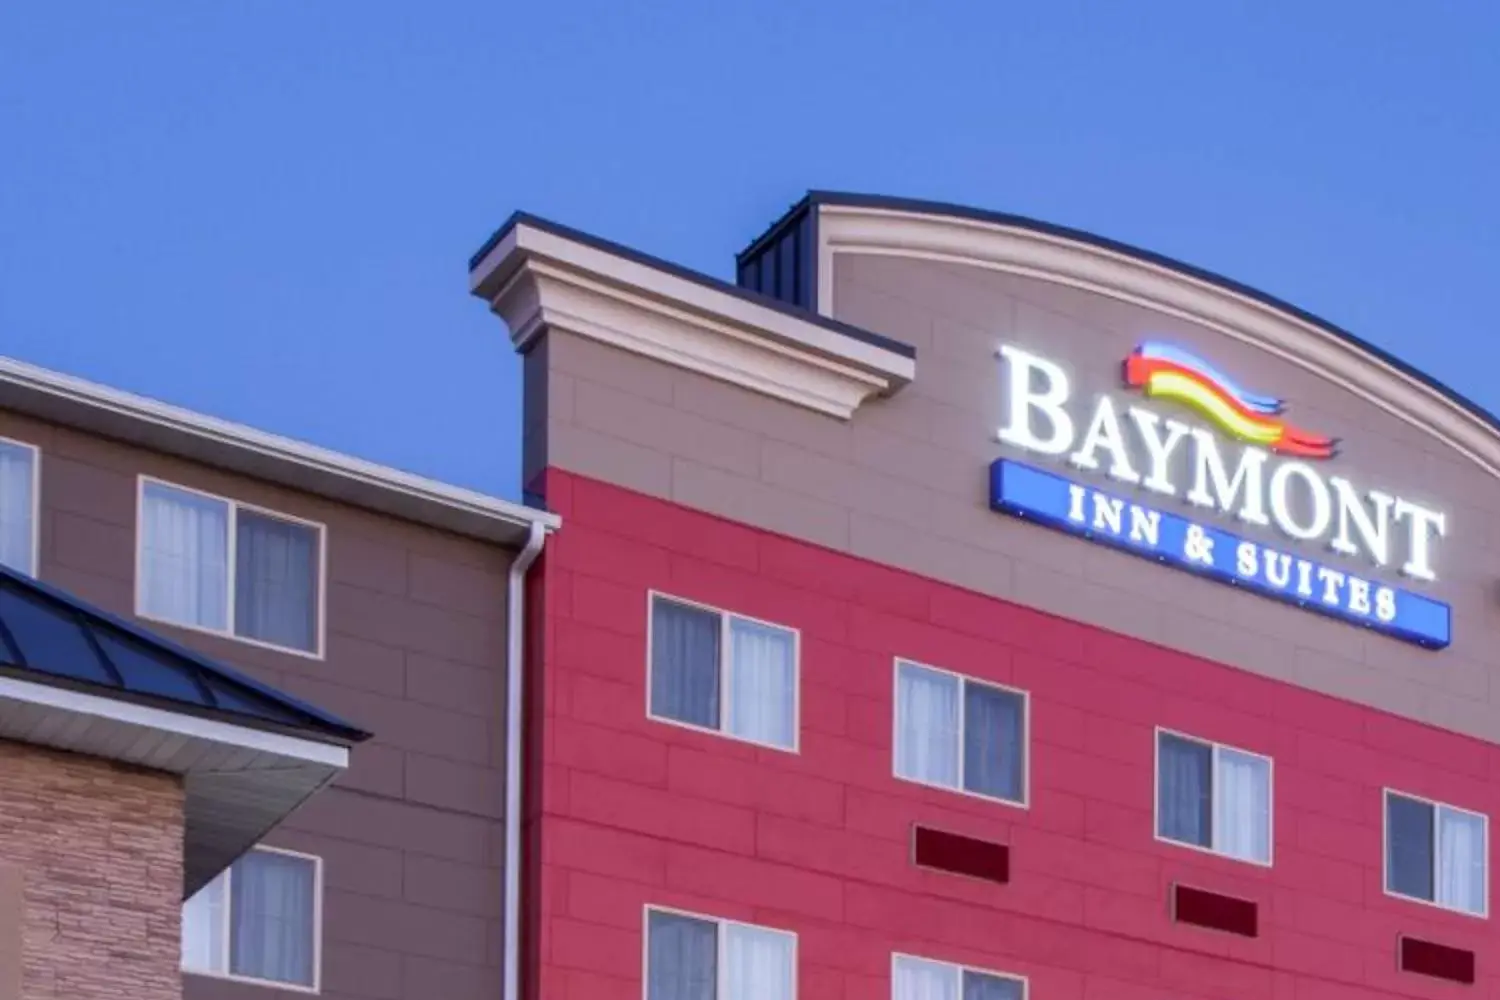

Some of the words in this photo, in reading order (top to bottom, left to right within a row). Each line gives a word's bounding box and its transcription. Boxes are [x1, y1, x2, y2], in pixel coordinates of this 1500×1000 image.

[998, 345, 1446, 580] BAYMONT
[1068, 484, 1160, 546] INN
[1184, 523, 1214, 566] &
[1236, 541, 1397, 622] SUITES
